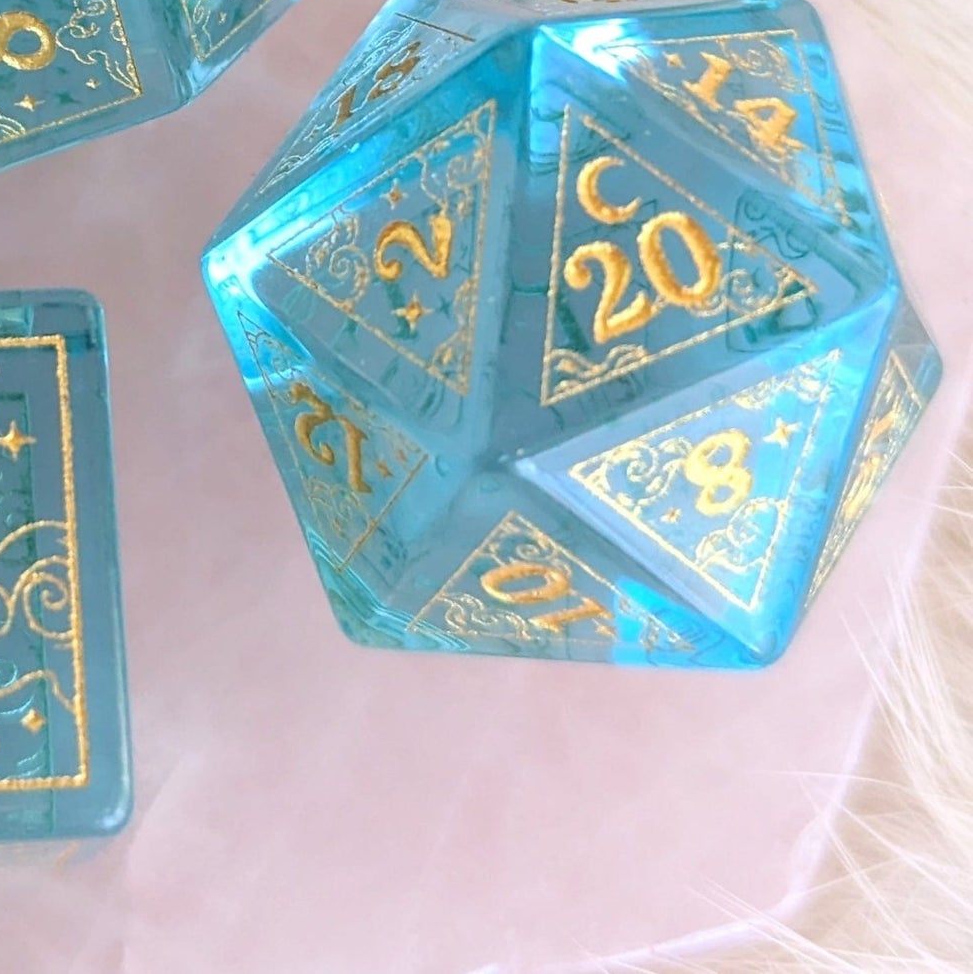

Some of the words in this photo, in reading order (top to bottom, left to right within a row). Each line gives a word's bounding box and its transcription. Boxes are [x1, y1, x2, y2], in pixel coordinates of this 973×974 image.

[678, 48, 805, 155] 14
[373, 213, 452, 281] 2
[565, 209, 724, 344] 20
[289, 382, 374, 494] 12
[683, 427, 753, 517] 8
[480, 561, 614, 633] 10
